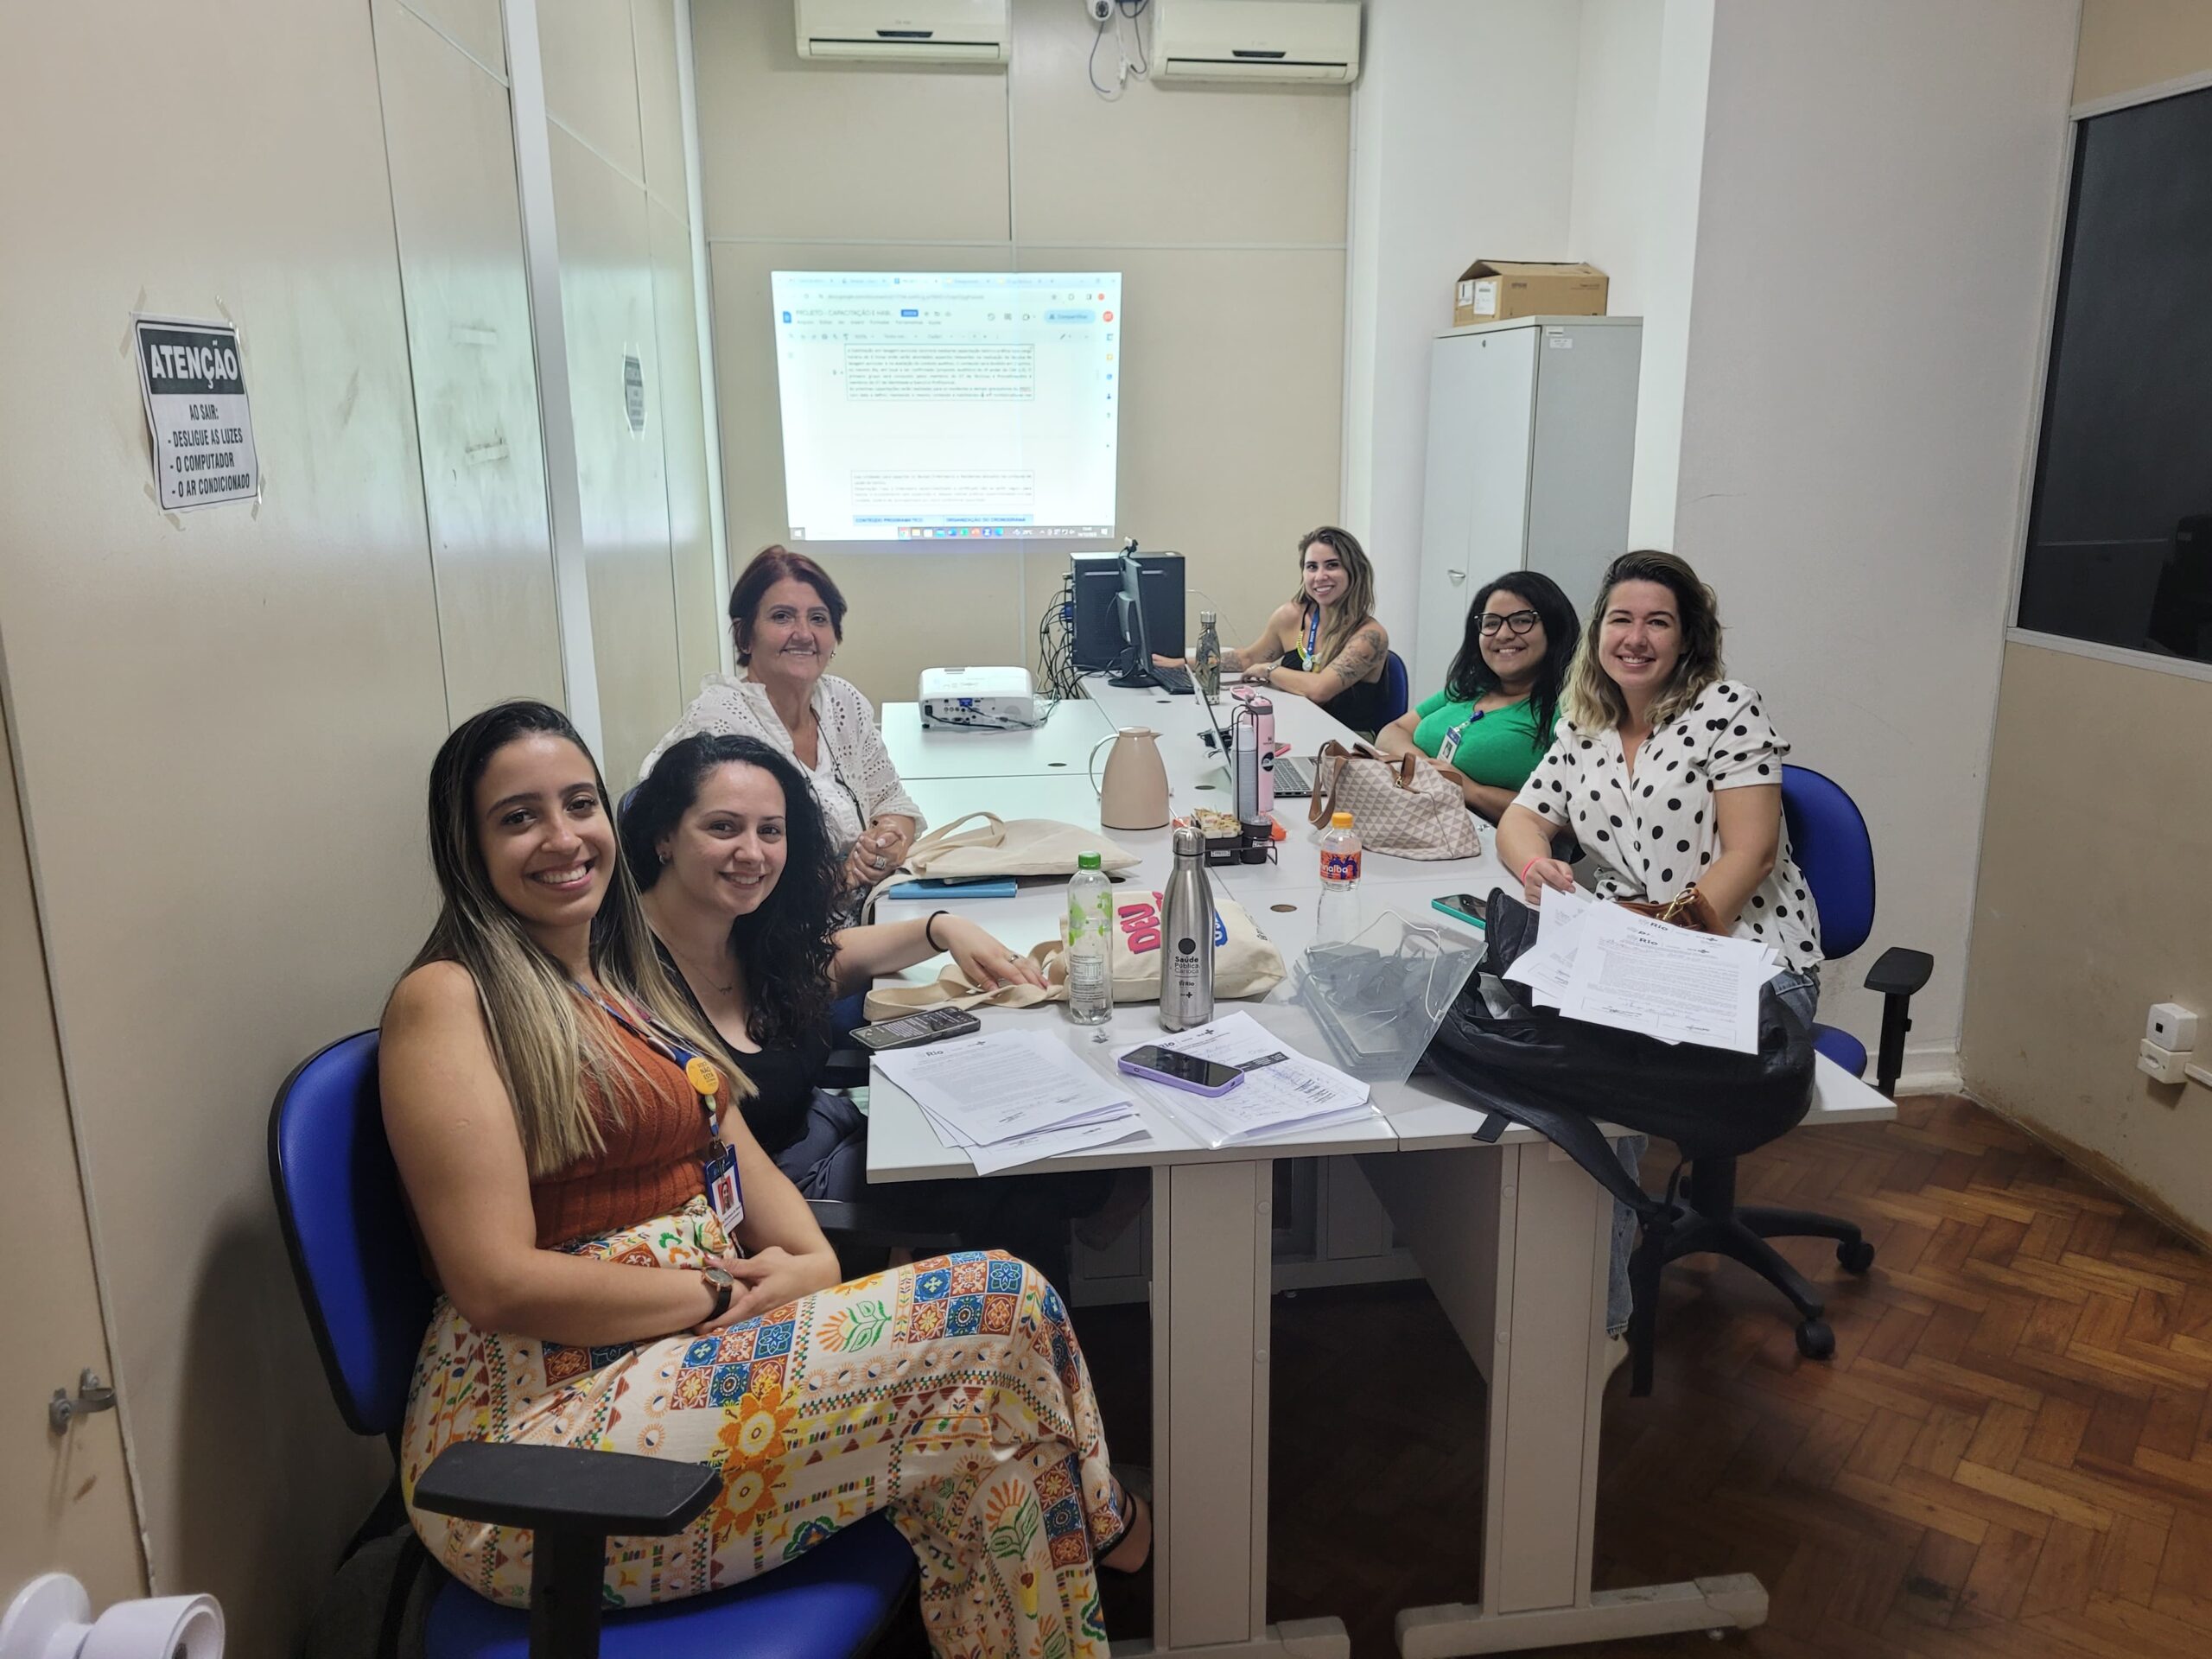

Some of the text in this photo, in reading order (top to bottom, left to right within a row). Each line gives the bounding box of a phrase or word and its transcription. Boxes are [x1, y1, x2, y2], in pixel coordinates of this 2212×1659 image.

[150, 340, 238, 389] ATENÇÃO
[188, 404, 219, 422] AO SAIR:
[173, 429, 210, 448] DESLIGUE
[211, 429, 220, 445] AS
[221, 428, 244, 444] LUZES
[175, 455, 182, 473] O
[183, 452, 235, 473] COMPUTADOR
[178, 480, 184, 498] O
[186, 480, 197, 497] AR
[198, 473, 251, 496] CONDICIONADO
[1649, 922, 1669, 931] Rio
[1639, 938, 1658, 946] Rio
